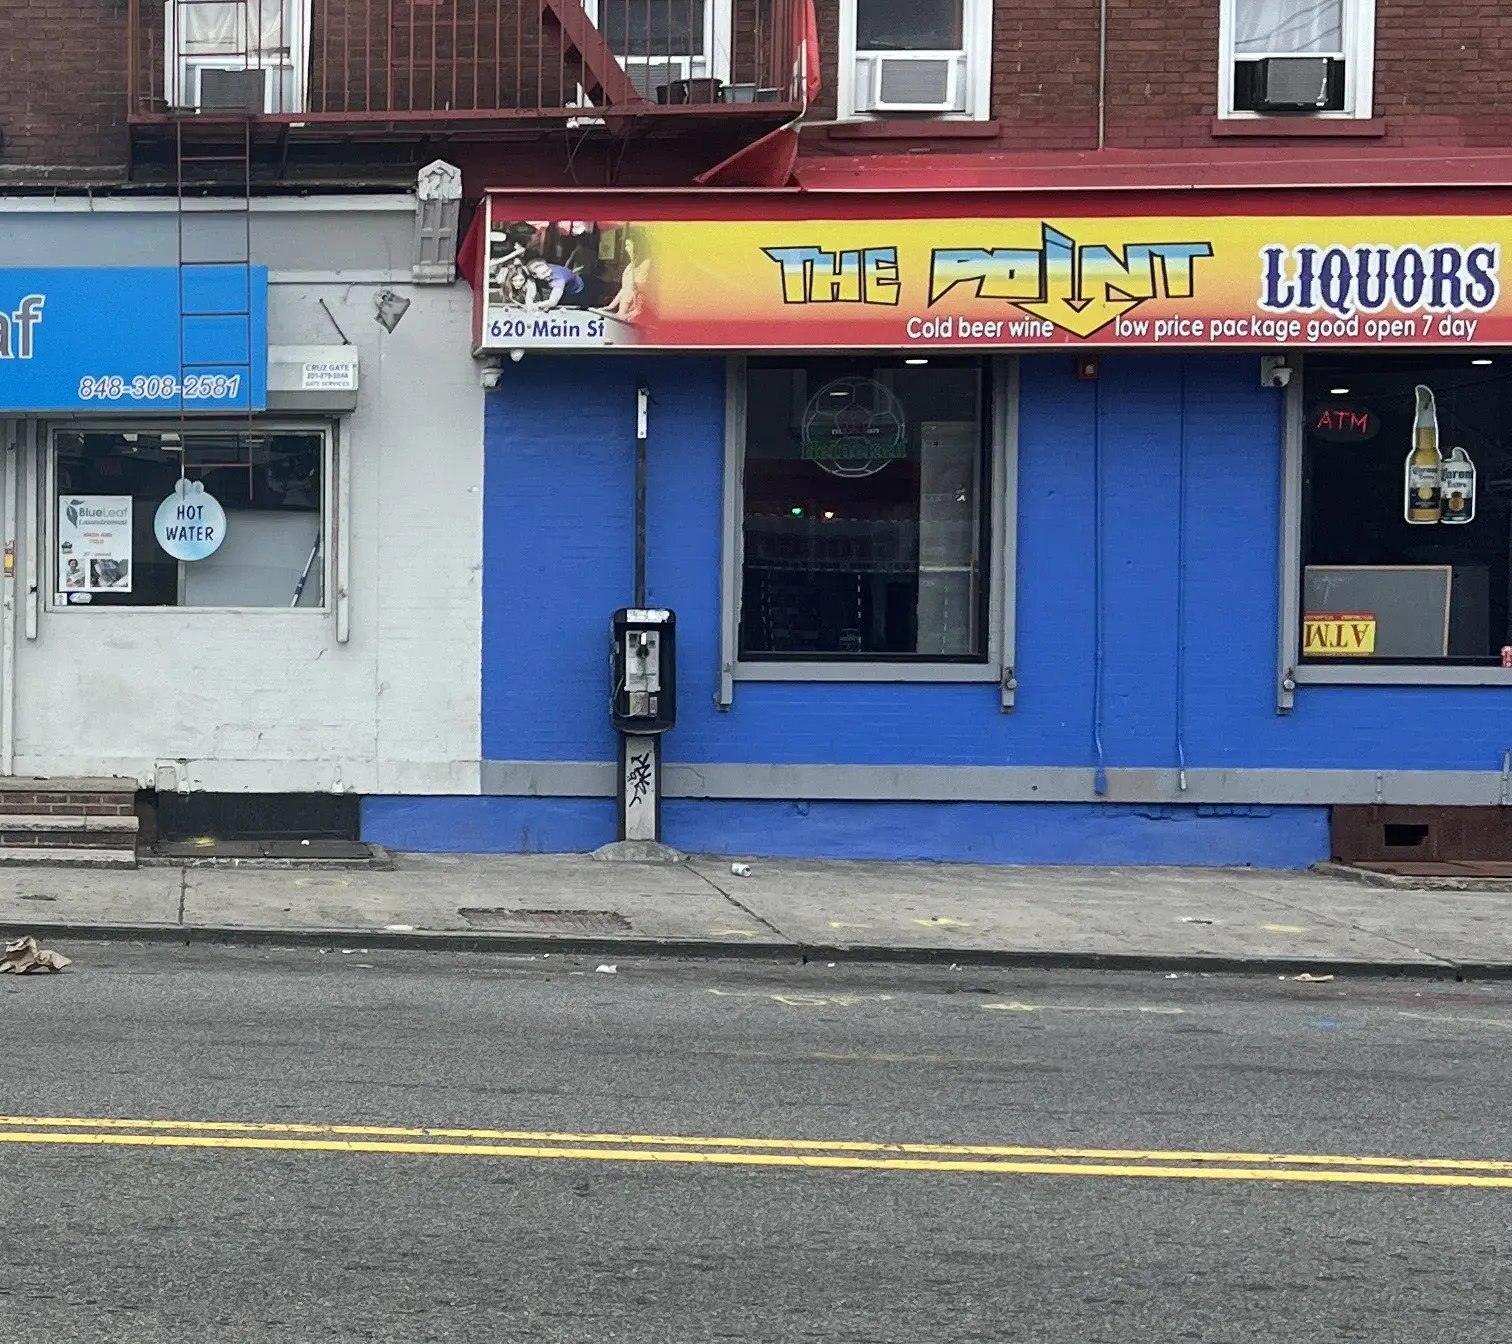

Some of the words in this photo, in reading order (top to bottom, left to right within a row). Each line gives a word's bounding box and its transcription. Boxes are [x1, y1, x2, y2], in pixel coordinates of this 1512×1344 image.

[760, 245, 902, 306] THE
[928, 222, 1214, 338] POINT
[1260, 244, 1498, 318] LIQUORS
[491, 320, 525, 338] 620
[532, 320, 580, 338] Main
[587, 318, 605, 338] St
[906, 316, 953, 339] Cold
[958, 316, 1002, 339] beer
[1009, 316, 1054, 338] wine
[1115, 315, 1149, 337] low
[1154, 316, 1204, 340] price
[1210, 316, 1300, 341] package
[1307, 316, 1359, 341] good
[1365, 319, 1415, 341] open
[1422, 316, 1432, 336] 7
[1438, 315, 1477, 340] day
[329, 364, 350, 372] GATE
[79, 375, 240, 400] 848-308-2581
[1317, 410, 1368, 434] ATM
[79, 508, 128, 518] BlueLeaf
[176, 505, 203, 520] HOT
[165, 525, 214, 542] WATER
[1305, 623, 1370, 648] ATM
